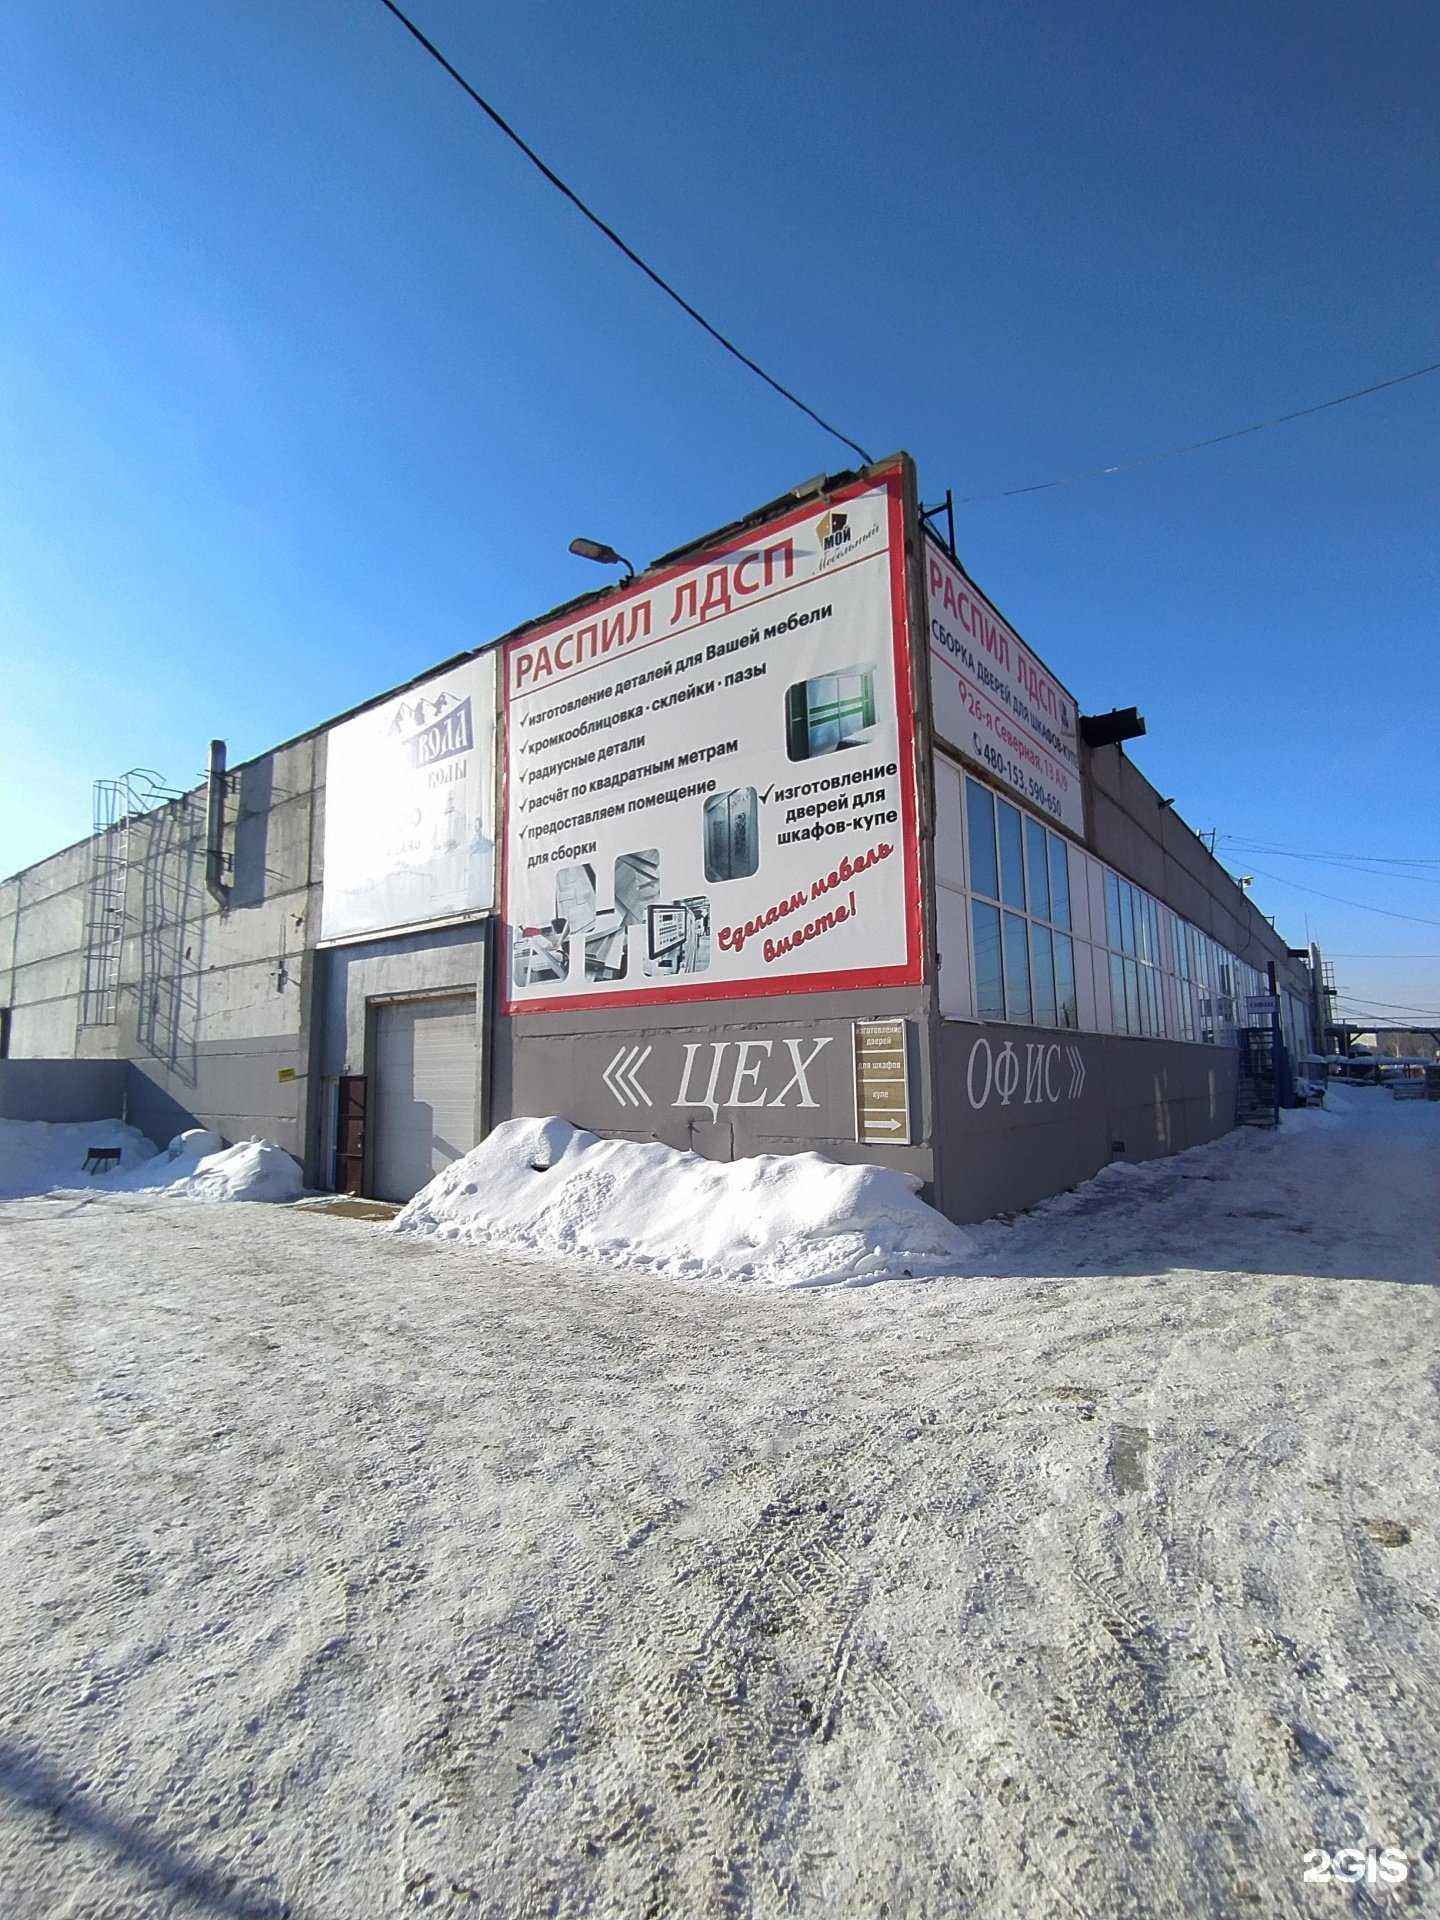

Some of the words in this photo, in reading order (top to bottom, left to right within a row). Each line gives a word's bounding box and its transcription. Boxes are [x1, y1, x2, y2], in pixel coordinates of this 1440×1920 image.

[824, 525, 851, 551] МОЙ
[516, 600, 652, 689] РАСПИЛ
[671, 538, 794, 625] ЛДСП
[930, 558, 1010, 672] РАСПИЛ
[1017, 655, 1058, 721] ЛДСП
[529, 686, 613, 727] изготовление
[614, 660, 673, 697] деталей
[675, 653, 703, 675] для
[706, 626, 760, 662] Вашей
[763, 603, 833, 640] мебели
[931, 618, 976, 673] СБОРКА
[976, 661, 1012, 706] ДВЕРЕЙ
[1013, 696, 1029, 722] ДЛЯ
[528, 705, 644, 755] кромкооблицовка
[651, 679, 715, 711] склейки
[724, 662, 767, 687] пазы
[968, 692, 993, 731] 26-я
[528, 751, 596, 784] радиусные
[597, 734, 646, 762] детали
[528, 787, 569, 812] расчёт
[571, 783, 588, 797] по
[589, 758, 675, 793] квадратным
[677, 739, 739, 768] метрам
[774, 762, 898, 803] изготовление
[527, 803, 625, 839] предоставляем
[628, 778, 717, 811] помещение
[777, 809, 898, 845] шкафов-купе
[786, 793, 849, 824] дверей
[852, 788, 886, 809] для
[1029, 777, 1062, 817] 590-650
[527, 851, 549, 869] для
[551, 840, 597, 864] сборки
[717, 890, 809, 952] Сделаем
[811, 842, 894, 900] мебель
[763, 890, 857, 963] вместе!
[671, 1037, 834, 1125] ЦЕХ
[967, 1038, 1062, 1110] ОФИС
